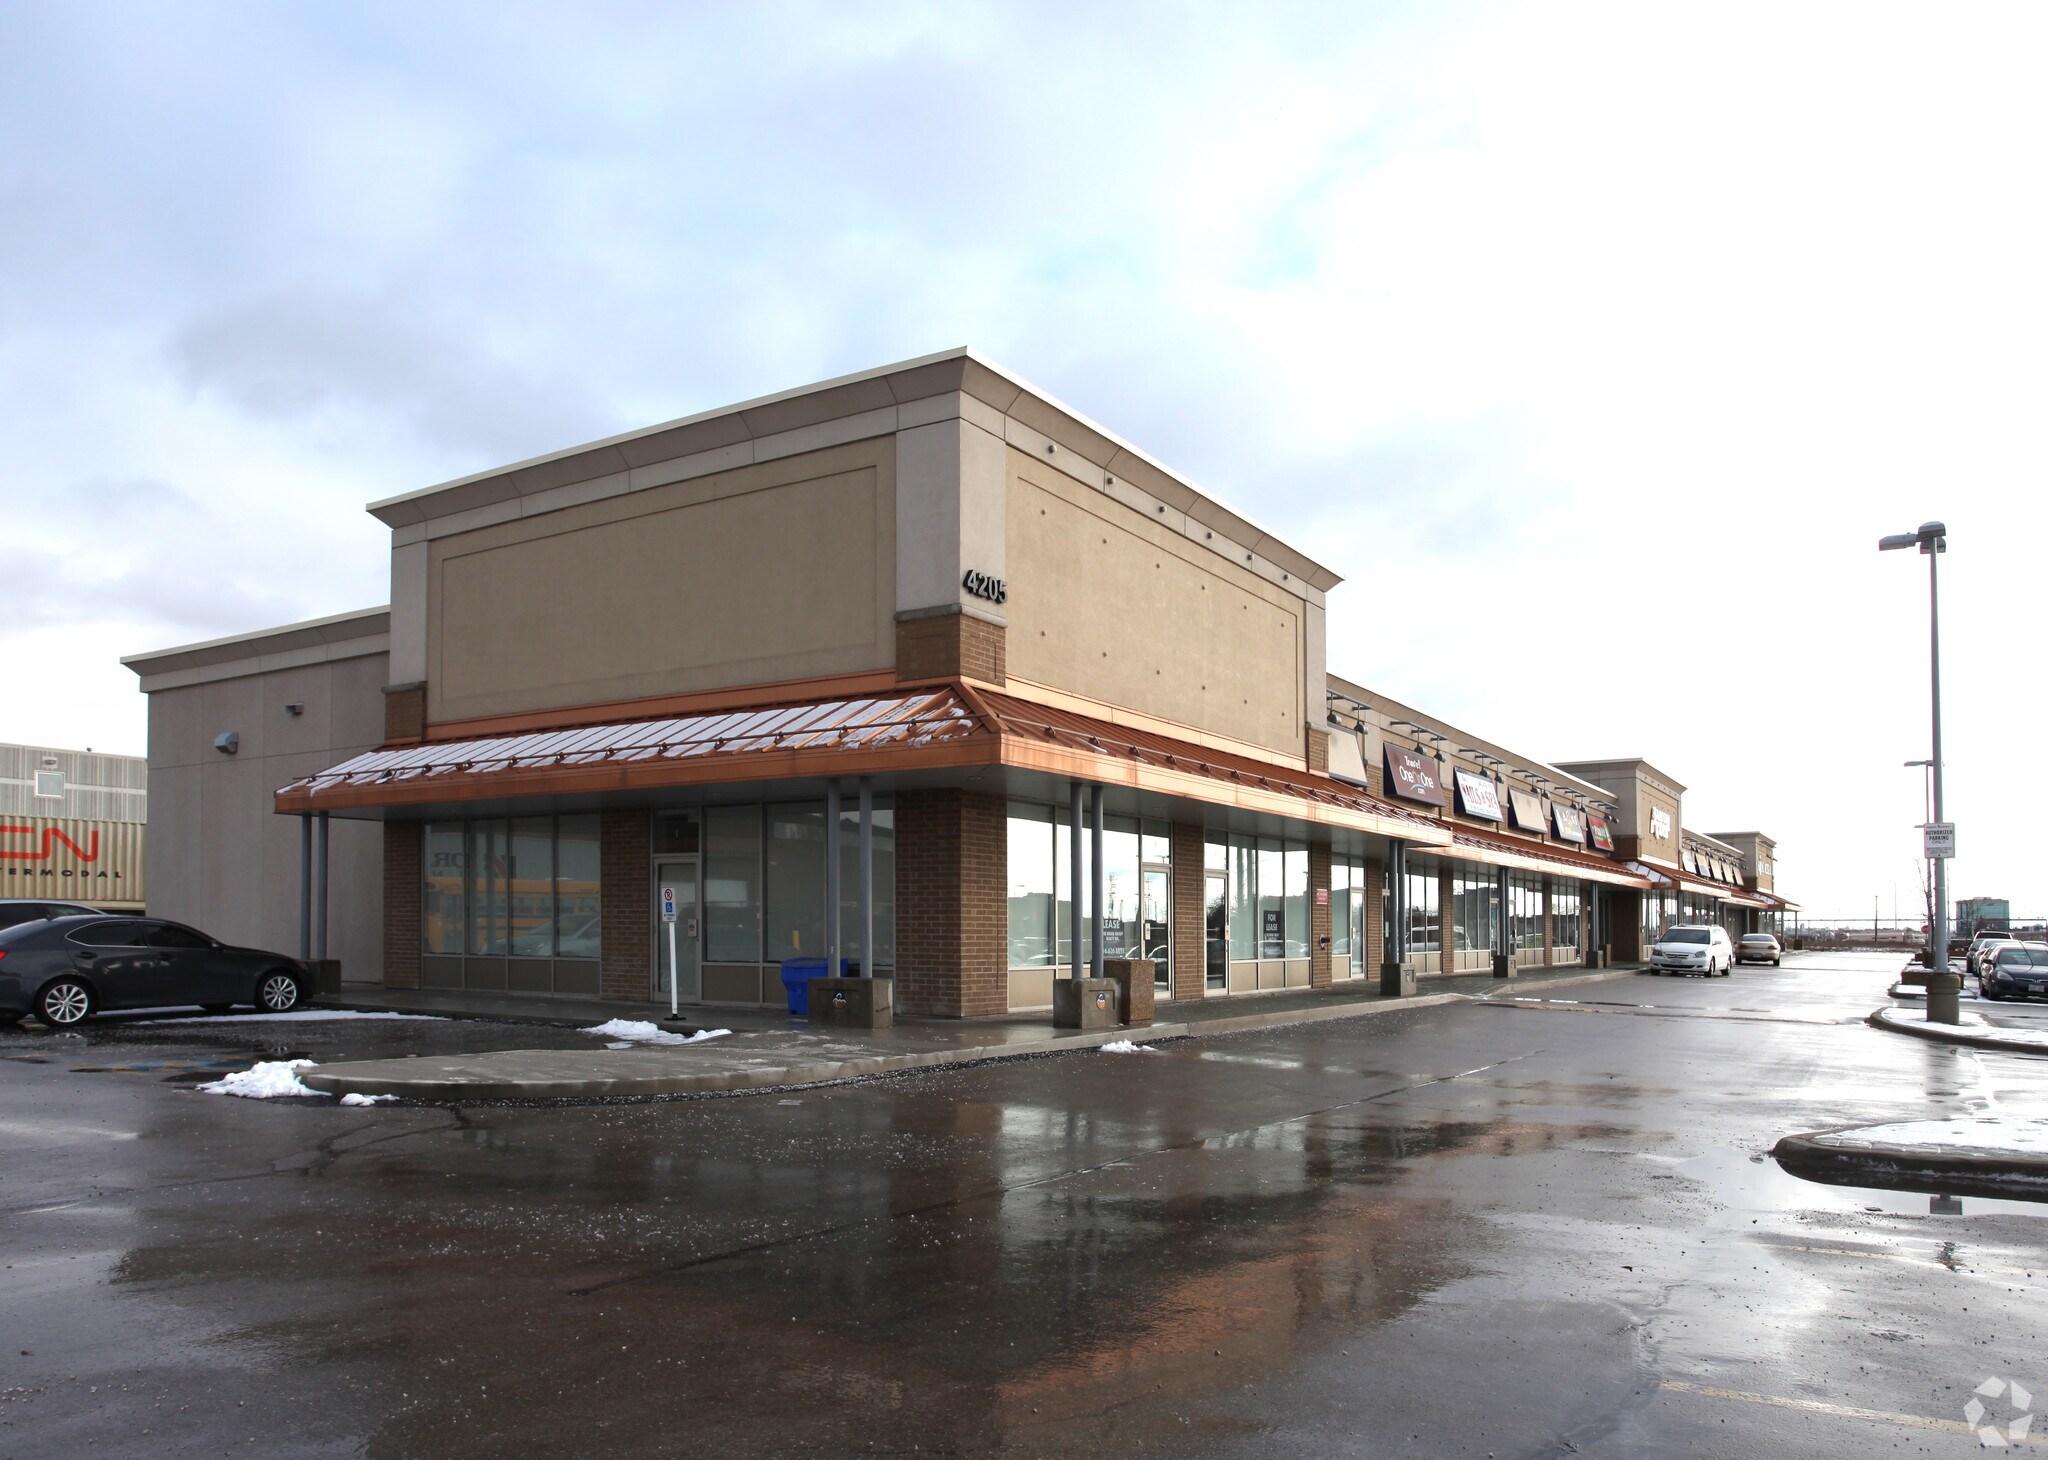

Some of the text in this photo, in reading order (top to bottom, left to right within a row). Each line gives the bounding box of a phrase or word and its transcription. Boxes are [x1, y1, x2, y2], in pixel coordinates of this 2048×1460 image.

[963, 569, 1008, 604] 4205
[1399, 765, 1414, 784] One
[1420, 771, 1434, 789] One
[0, 867, 122, 879] ERMODAL
[1267, 913, 1277, 922] FOR
[1265, 923, 1278, 931] LEASE
